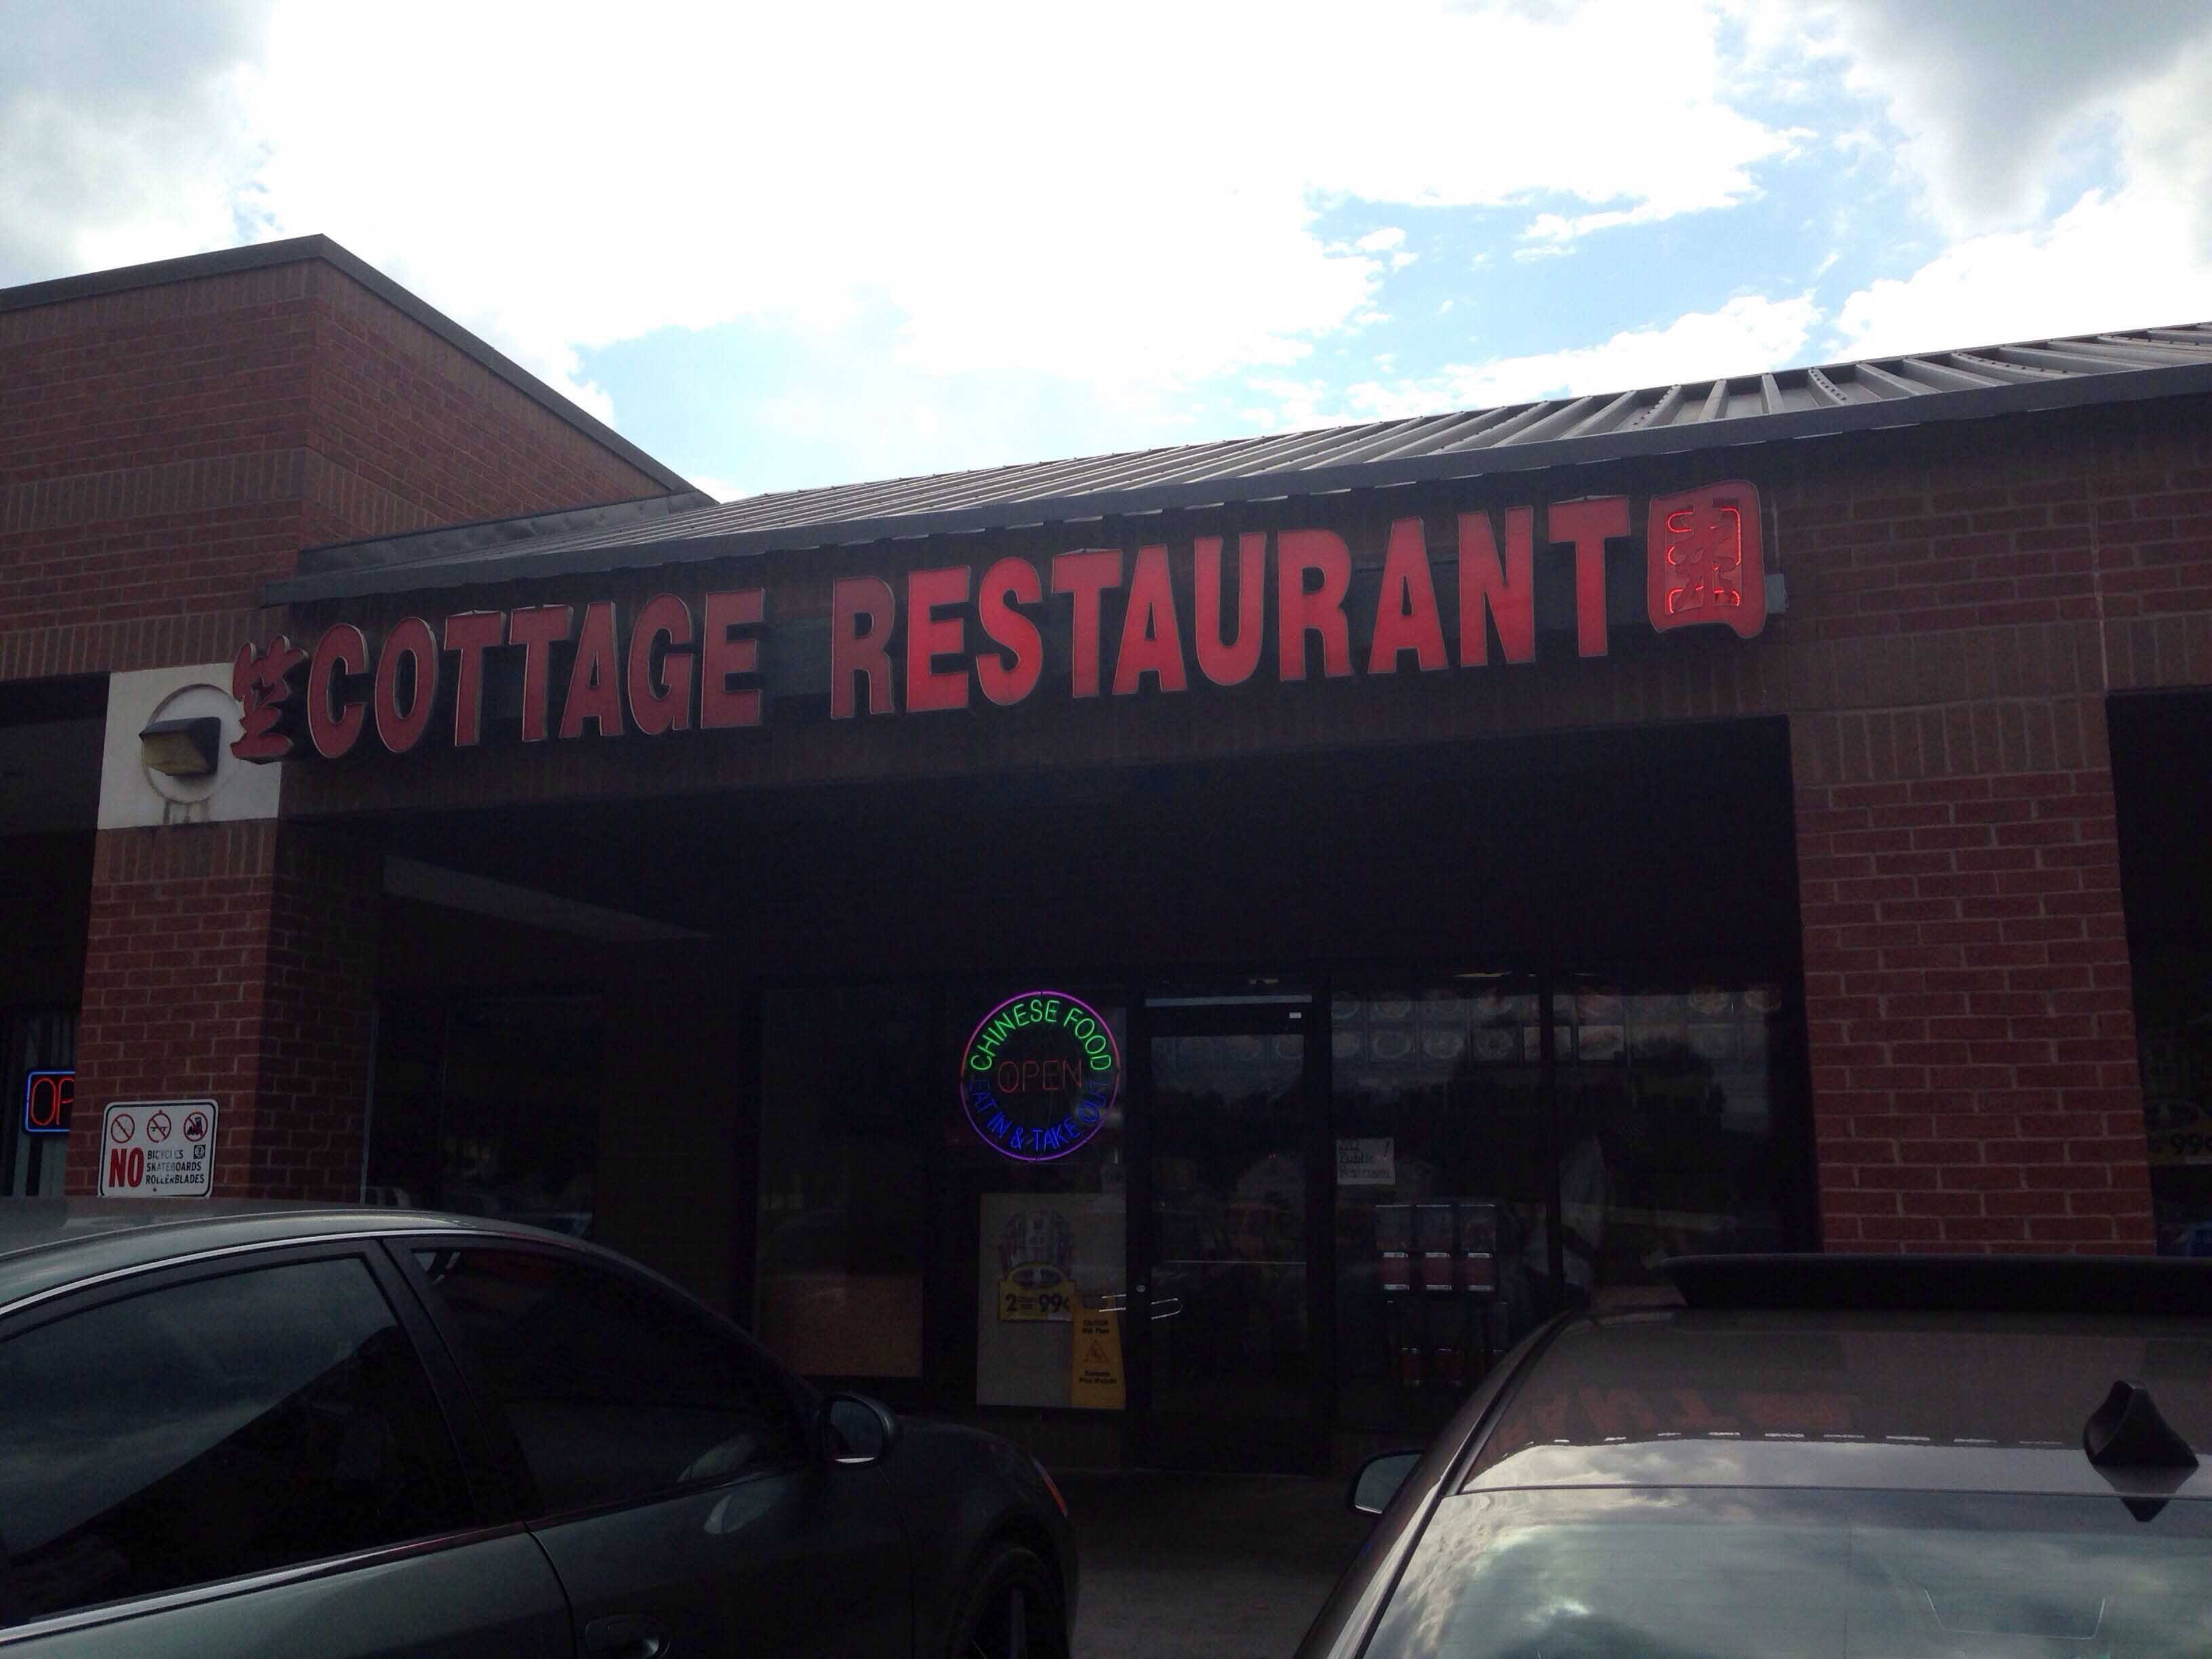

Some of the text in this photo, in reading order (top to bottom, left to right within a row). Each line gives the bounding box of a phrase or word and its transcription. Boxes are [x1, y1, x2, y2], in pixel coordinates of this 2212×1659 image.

[307, 495, 1631, 758] COTTAGE RESTAURANT
[970, 999, 1112, 1071] CHINESE FOOD
[998, 1059, 1083, 1094] OPEN
[1008, 1125, 1025, 1150] &
[1030, 1115, 1082, 1151] TAKE
[109, 1147, 144, 1187] NO
[146, 1162, 201, 1172] SKATEBOARDS
[147, 1149, 184, 1160] BICYCLES
[146, 1174, 204, 1184] ROLLERBLADES
[1006, 1293, 1017, 1312] 2
